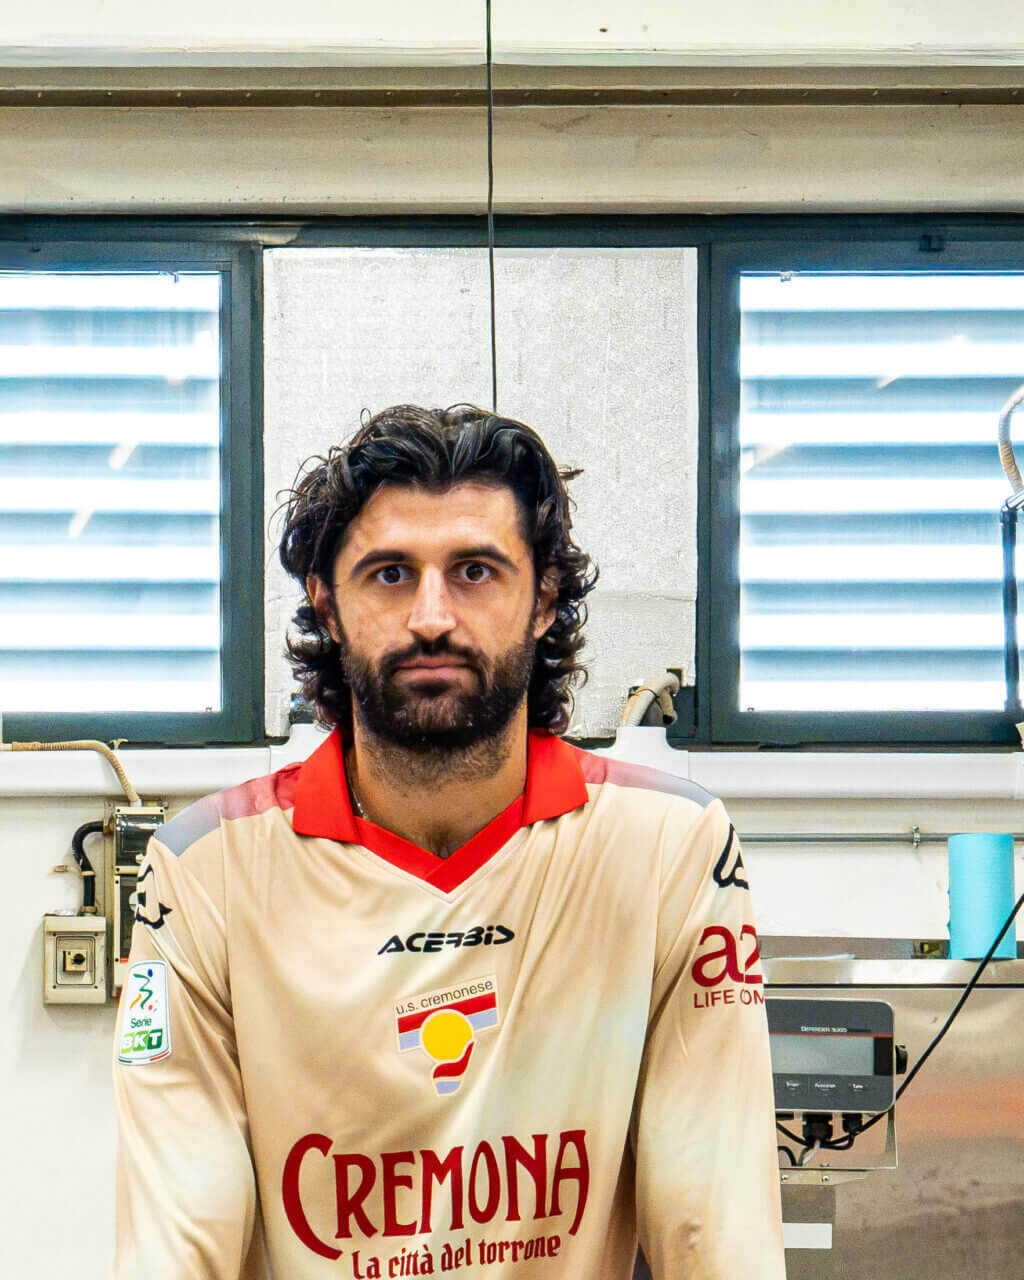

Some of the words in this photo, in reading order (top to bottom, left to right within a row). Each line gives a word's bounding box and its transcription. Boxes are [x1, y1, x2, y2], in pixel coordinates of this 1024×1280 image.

[396, 1001, 418, 1015] u.s.
[420, 980, 494, 1009] cremonese
[694, 989, 735, 1008] LIFE
[130, 1017, 152, 1029] Serie
[281, 1129, 590, 1261] CREMONA
[351, 1250, 381, 1280] La
[387, 1244, 434, 1278] città
[440, 1237, 472, 1272] del
[478, 1234, 561, 1266] torrone
